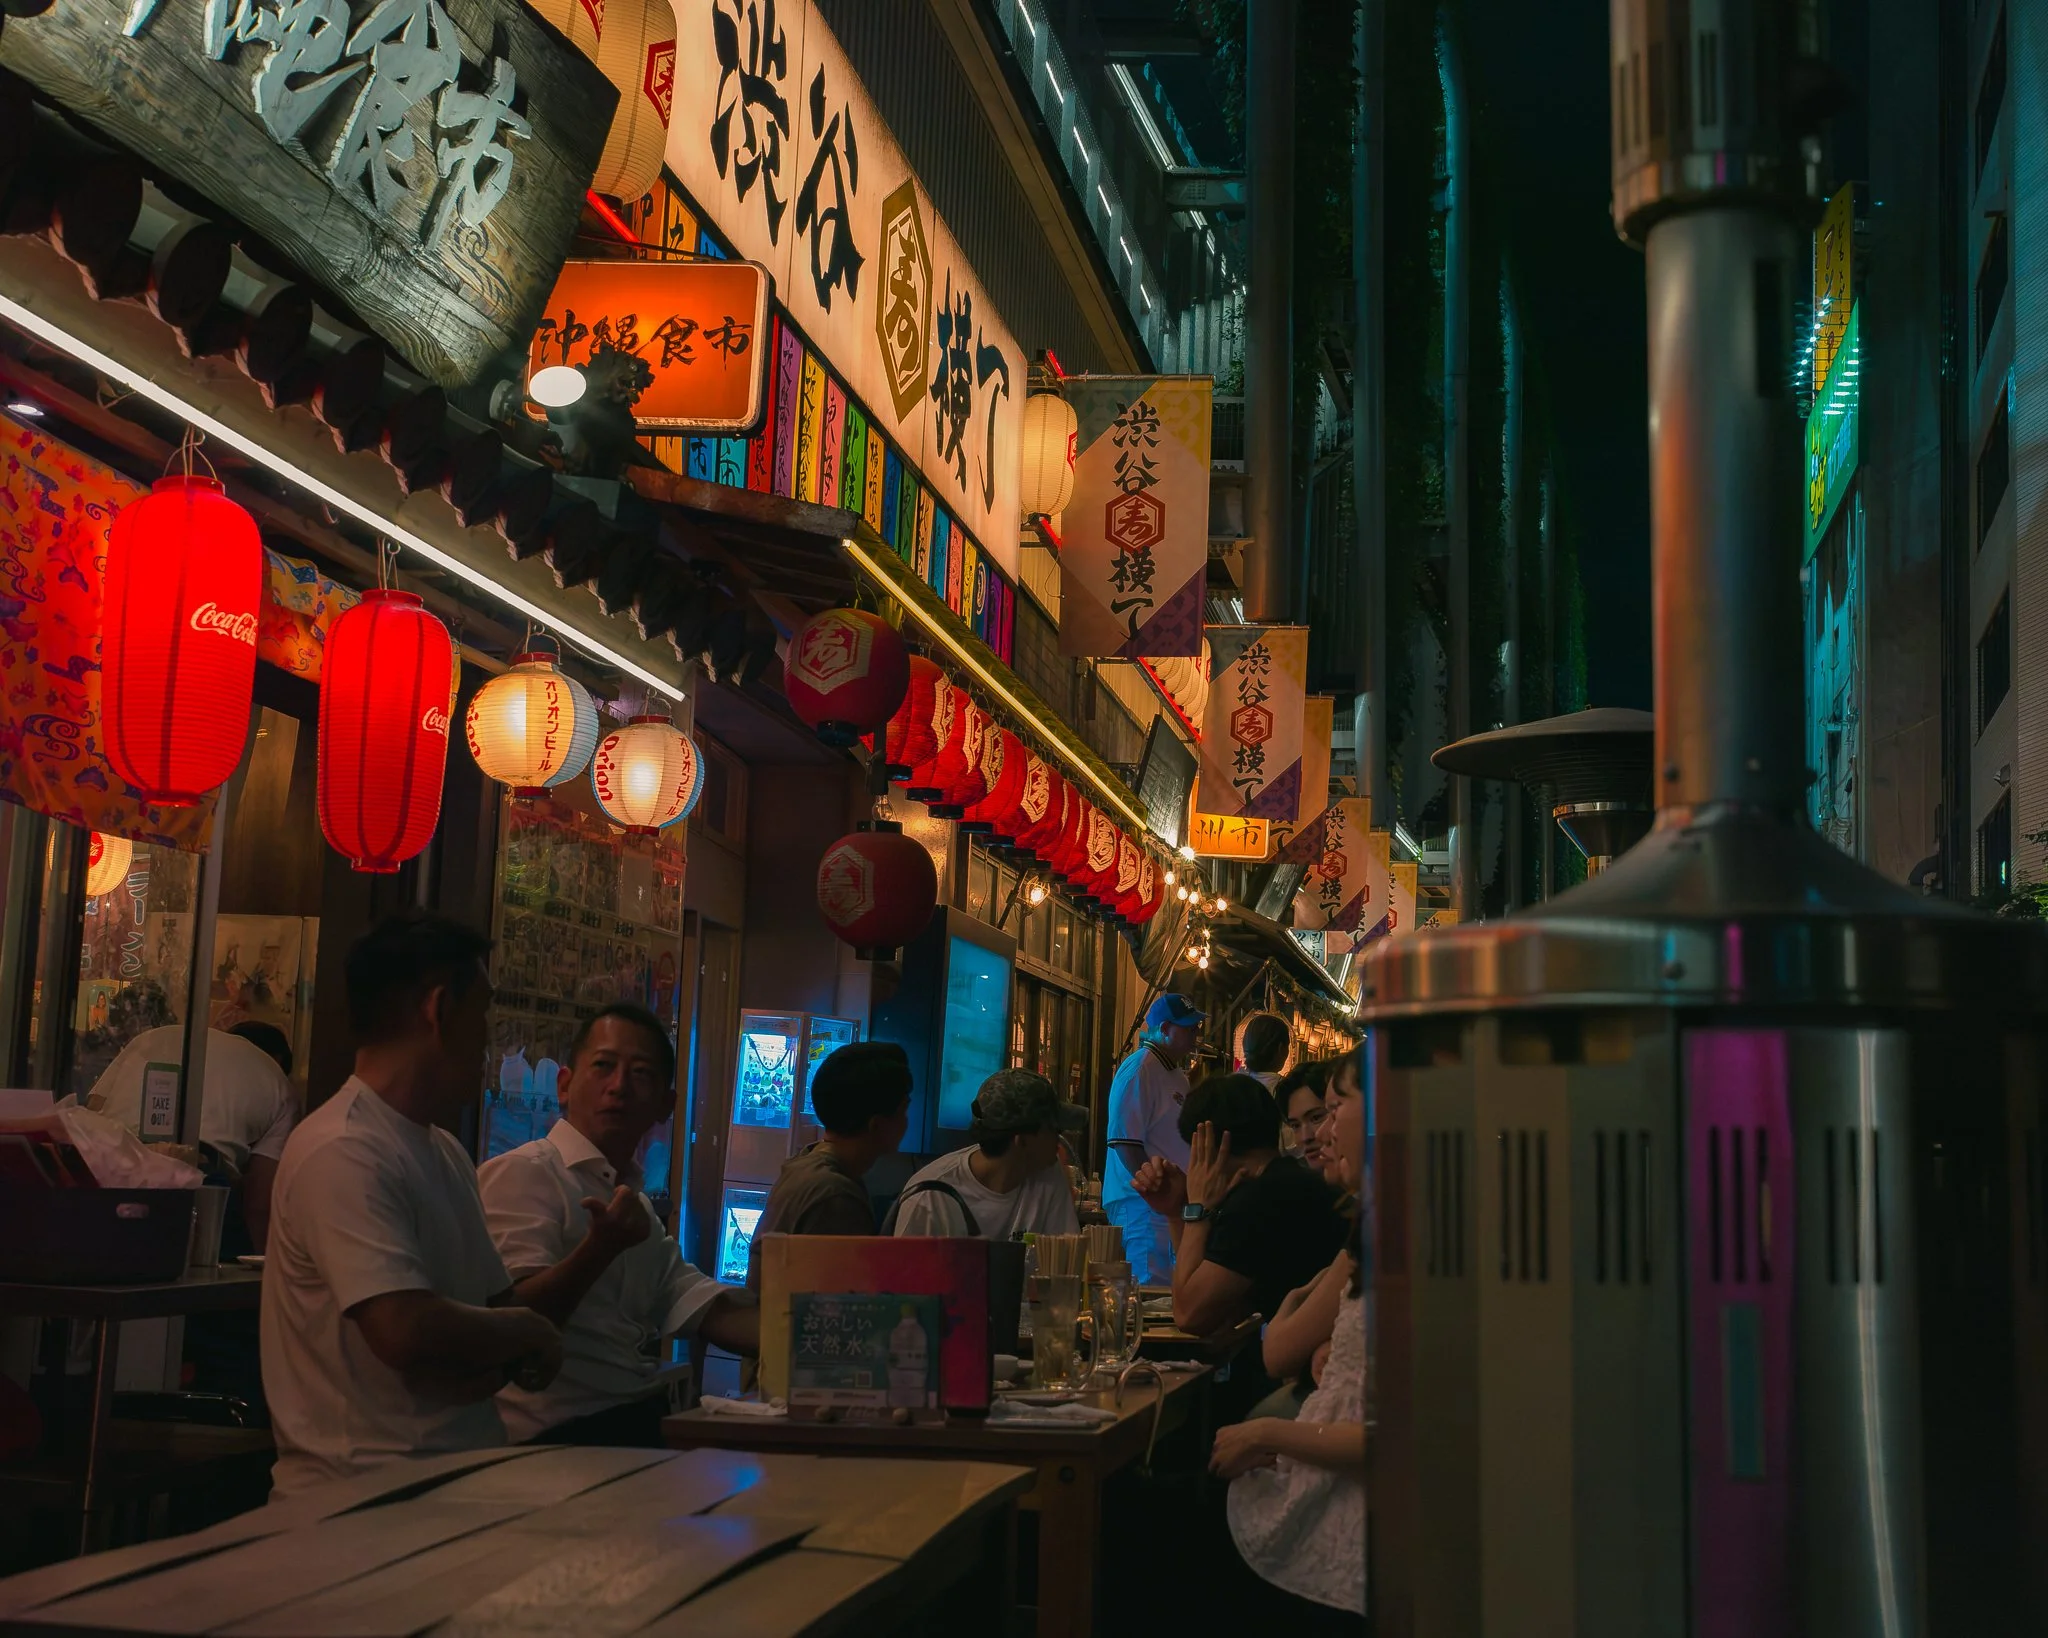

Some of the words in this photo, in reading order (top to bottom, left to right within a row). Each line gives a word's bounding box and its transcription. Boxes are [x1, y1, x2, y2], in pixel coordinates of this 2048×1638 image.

[537, 680, 560, 772] オリオンビール
[596, 735, 620, 801] Orion
[664, 737, 694, 816] オリオンビール
[152, 1096, 170, 1110] TAKE
[800, 1333, 863, 1356] 天然水
[802, 1313, 873, 1332] おいしい
